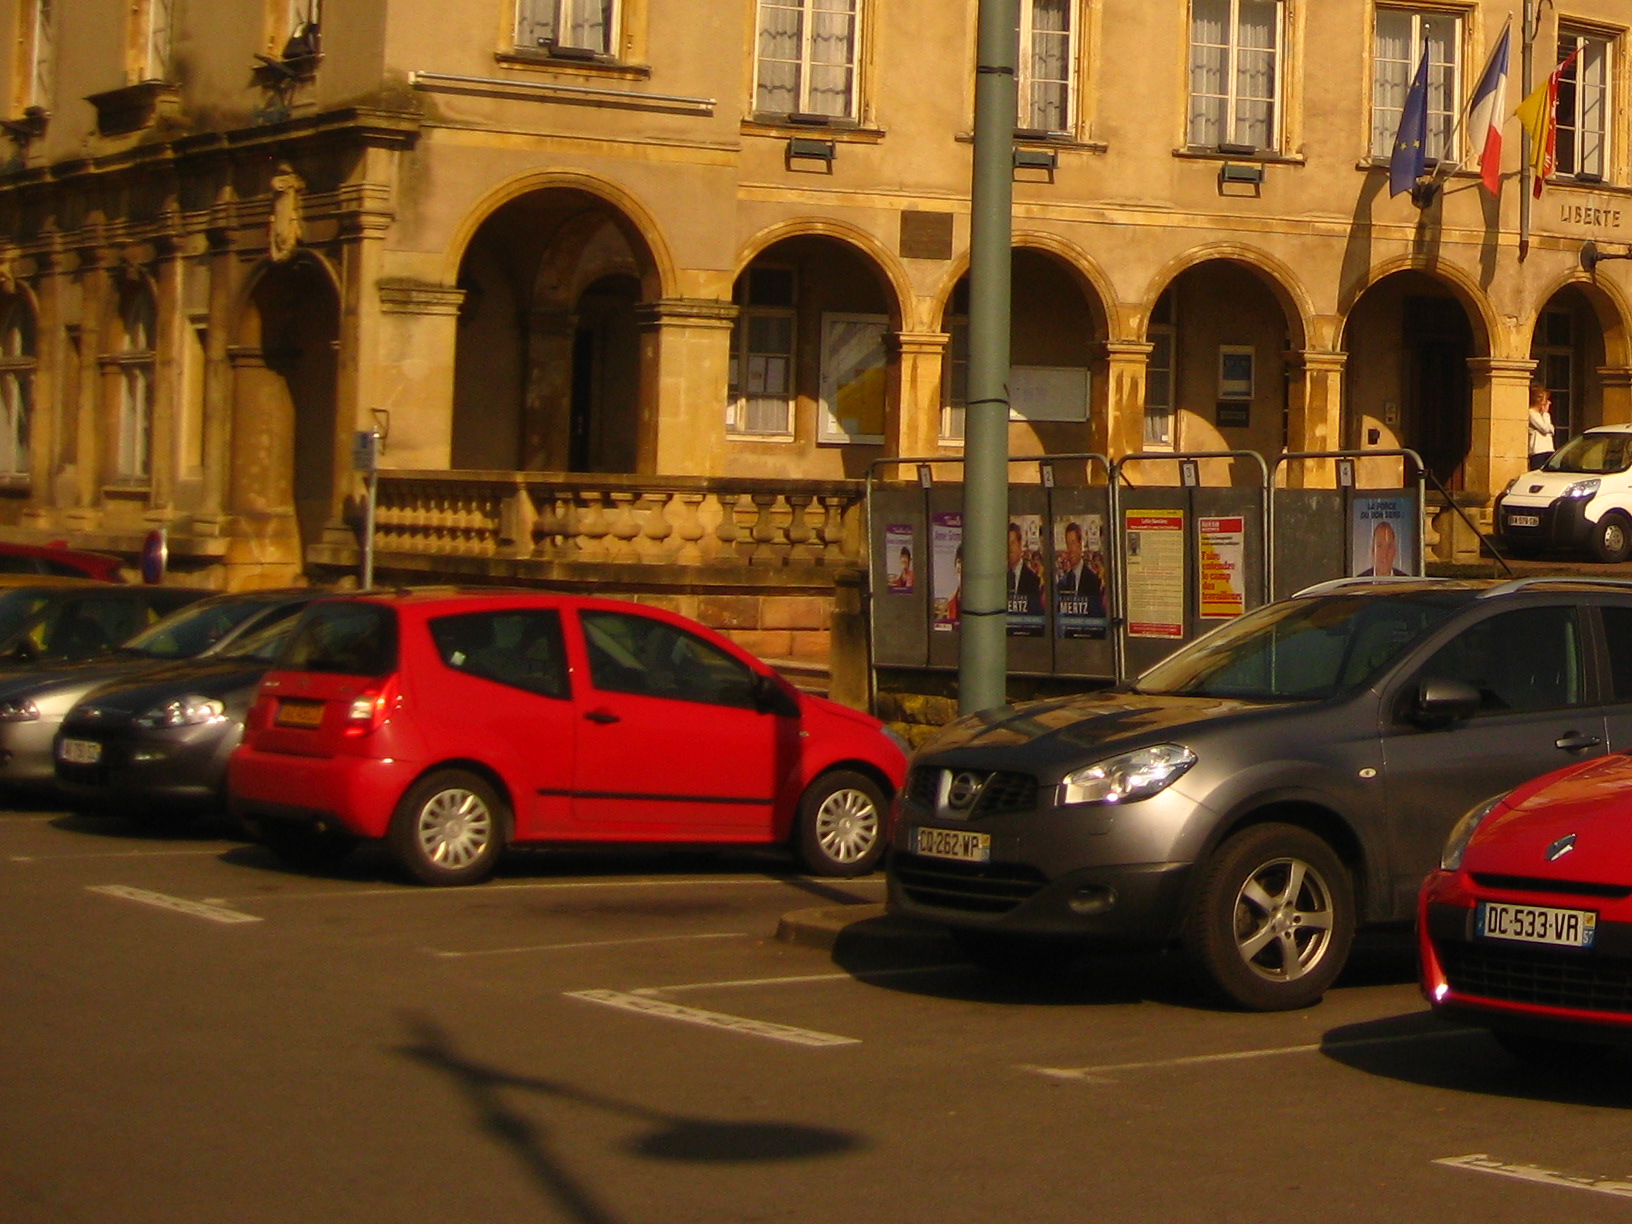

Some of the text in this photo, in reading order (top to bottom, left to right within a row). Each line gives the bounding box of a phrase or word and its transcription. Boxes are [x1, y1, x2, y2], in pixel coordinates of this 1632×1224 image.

[1560, 204, 1621, 228] LIBERTE
[1060, 601, 1089, 615] MERTZ
[1487, 906, 1580, 942] DC-533-VR
